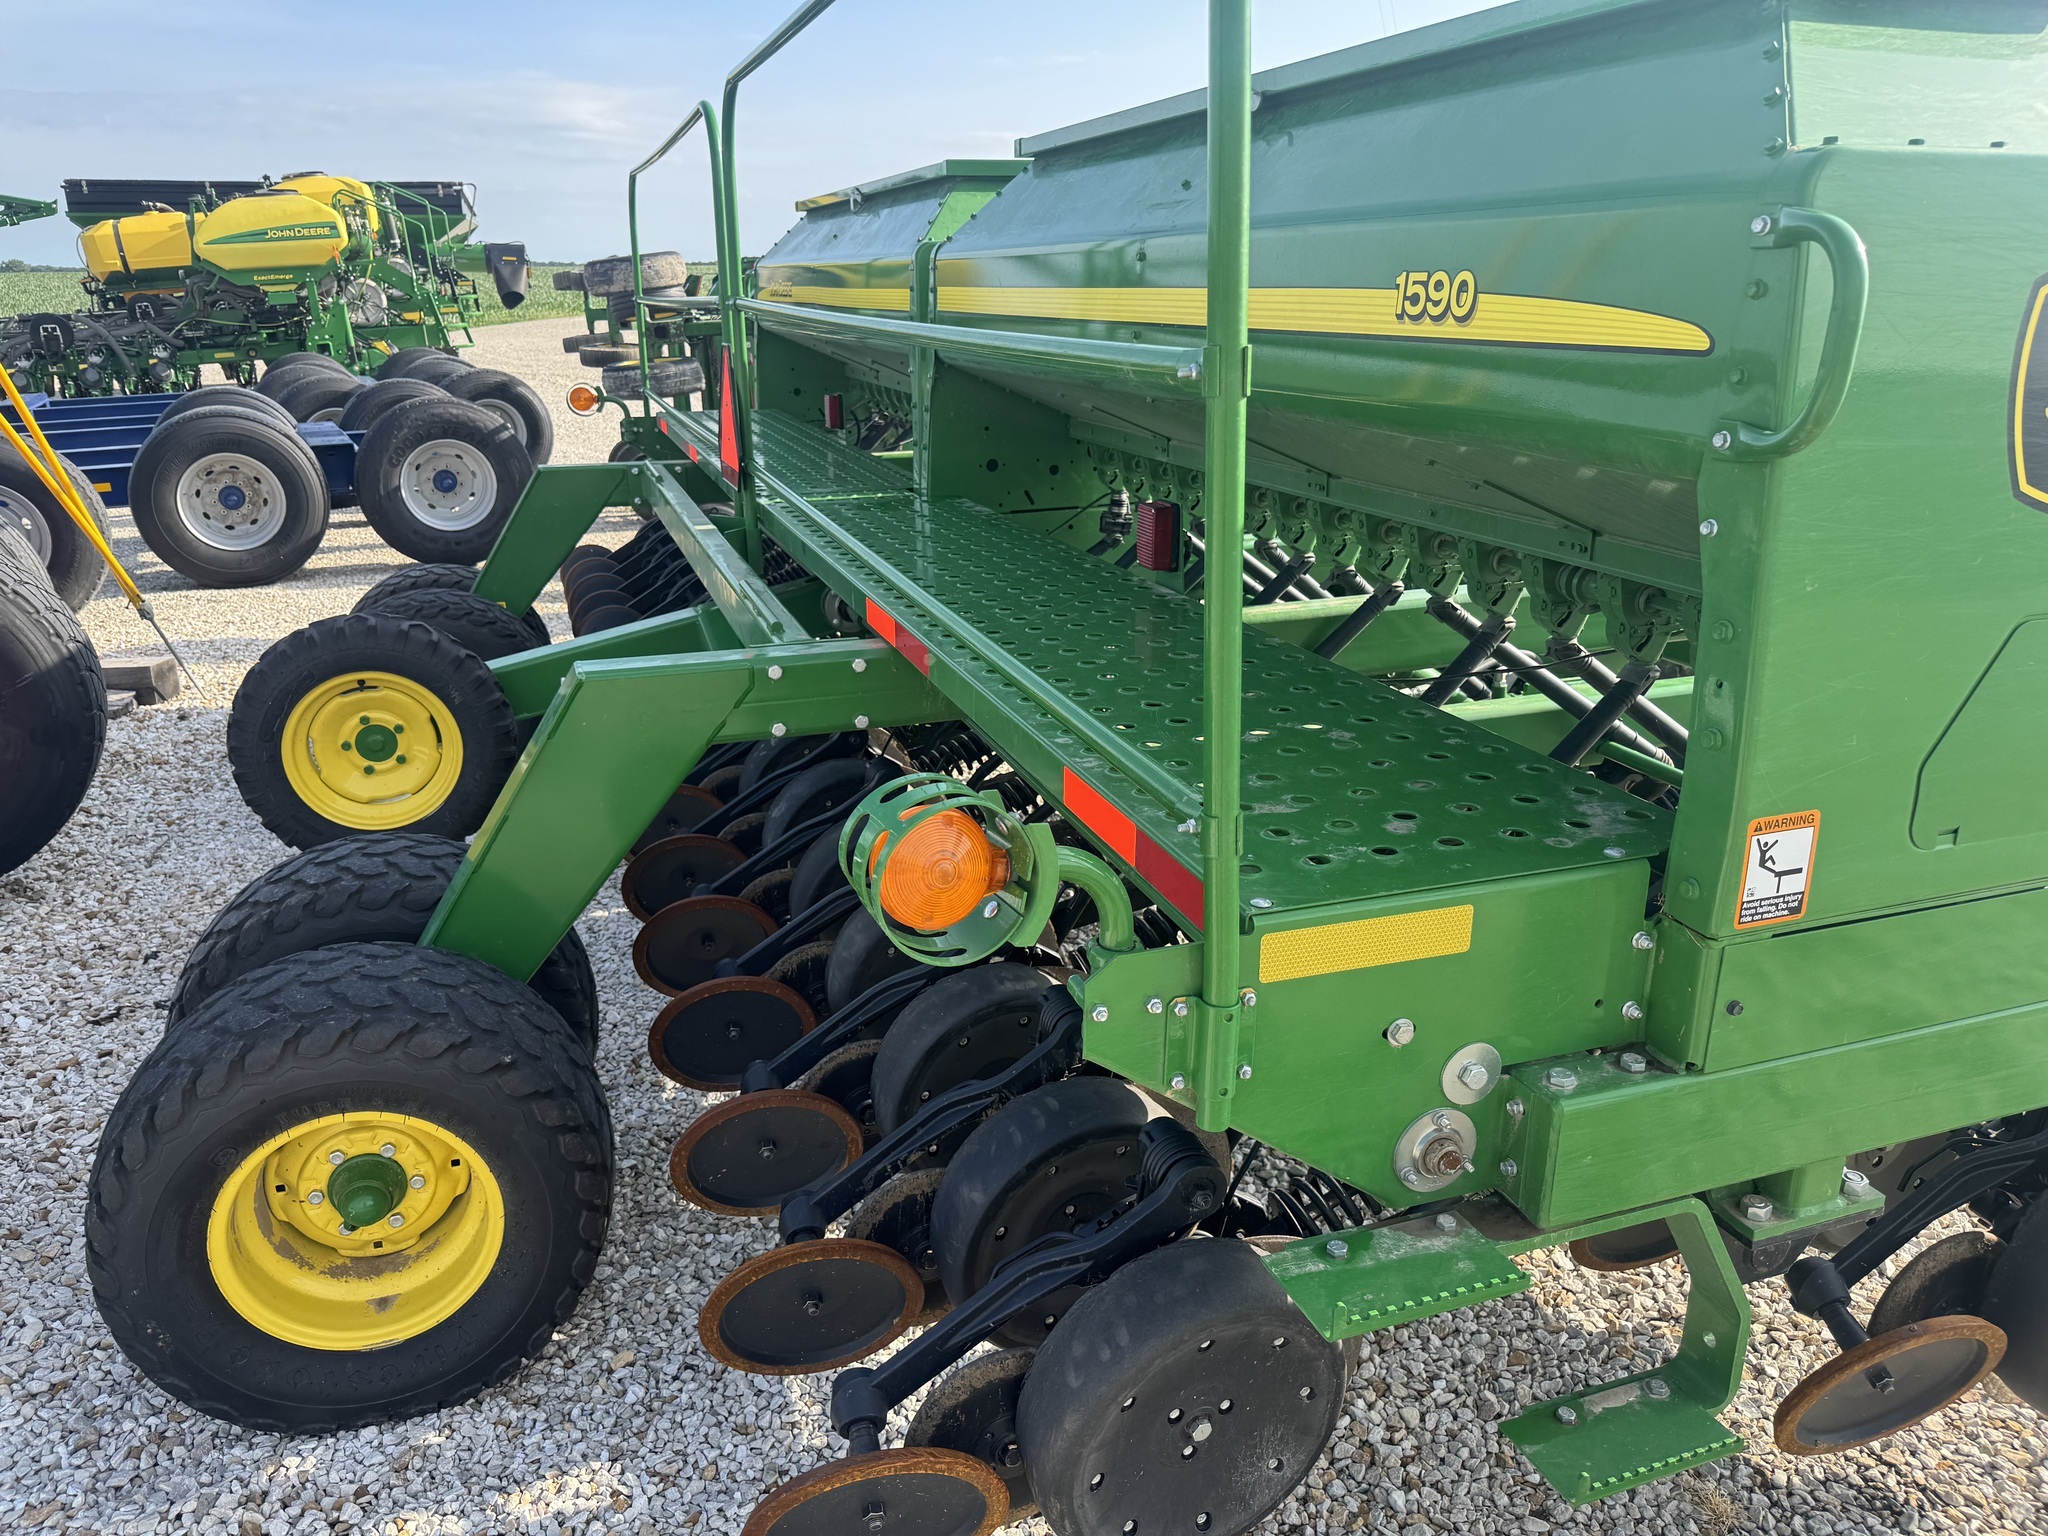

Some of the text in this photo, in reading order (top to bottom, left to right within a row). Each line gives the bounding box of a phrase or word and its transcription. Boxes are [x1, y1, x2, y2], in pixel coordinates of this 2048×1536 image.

[264, 227, 331, 239] JOHN DEERE
[1395, 269, 1477, 323] 1590
[1763, 813, 1815, 831] WARNING
[1742, 893, 1803, 909] Avoid serious injury
[1741, 908, 1755, 916] from
[1757, 905, 1777, 914] falling.
[1762, 909, 1790, 919] machine.
